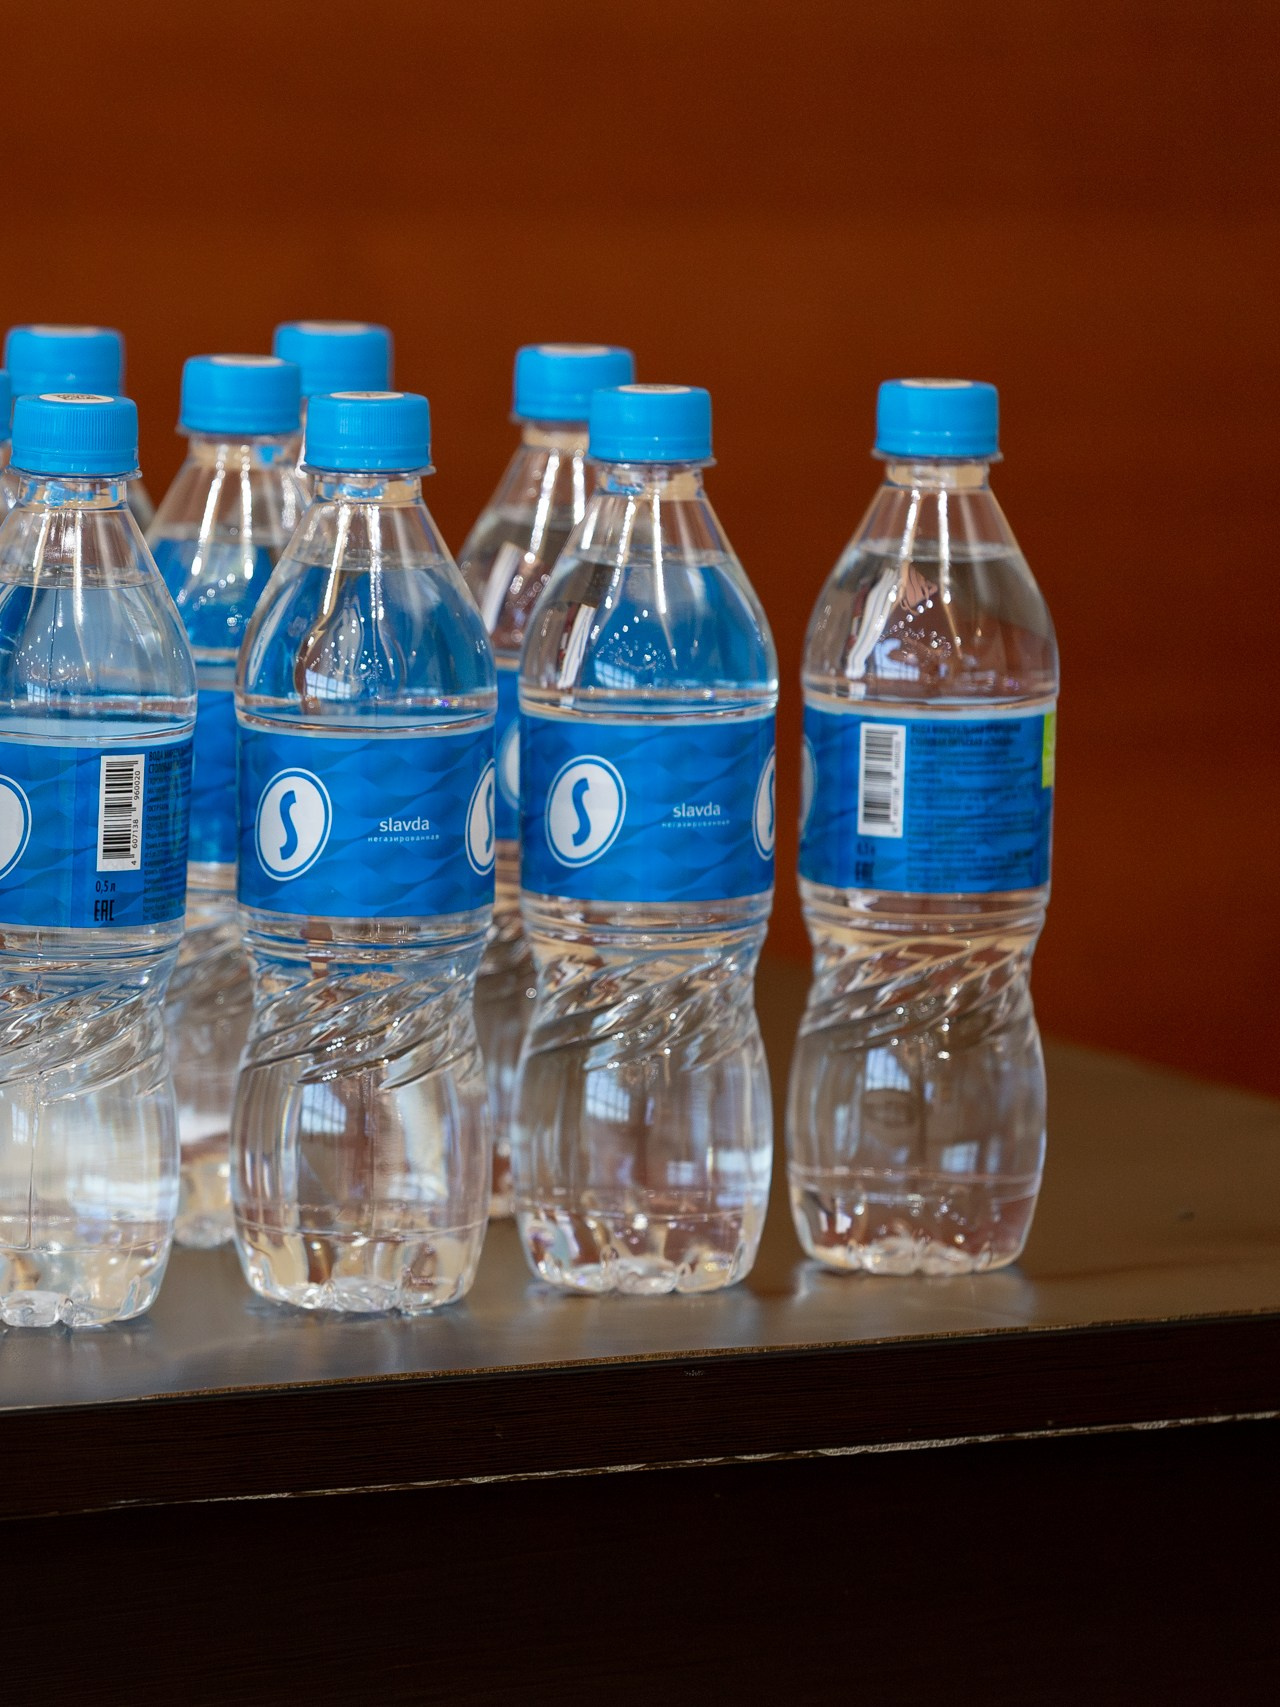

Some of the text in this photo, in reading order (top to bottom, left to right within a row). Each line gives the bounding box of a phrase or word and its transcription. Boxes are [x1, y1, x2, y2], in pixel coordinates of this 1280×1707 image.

[133, 770, 141, 801] 960020
[673, 801, 721, 818] slavda
[379, 816, 429, 832] slavda
[131, 860, 137, 870] 4
[95, 880, 109, 894] 0,5
[94, 899, 115, 922] EAC
